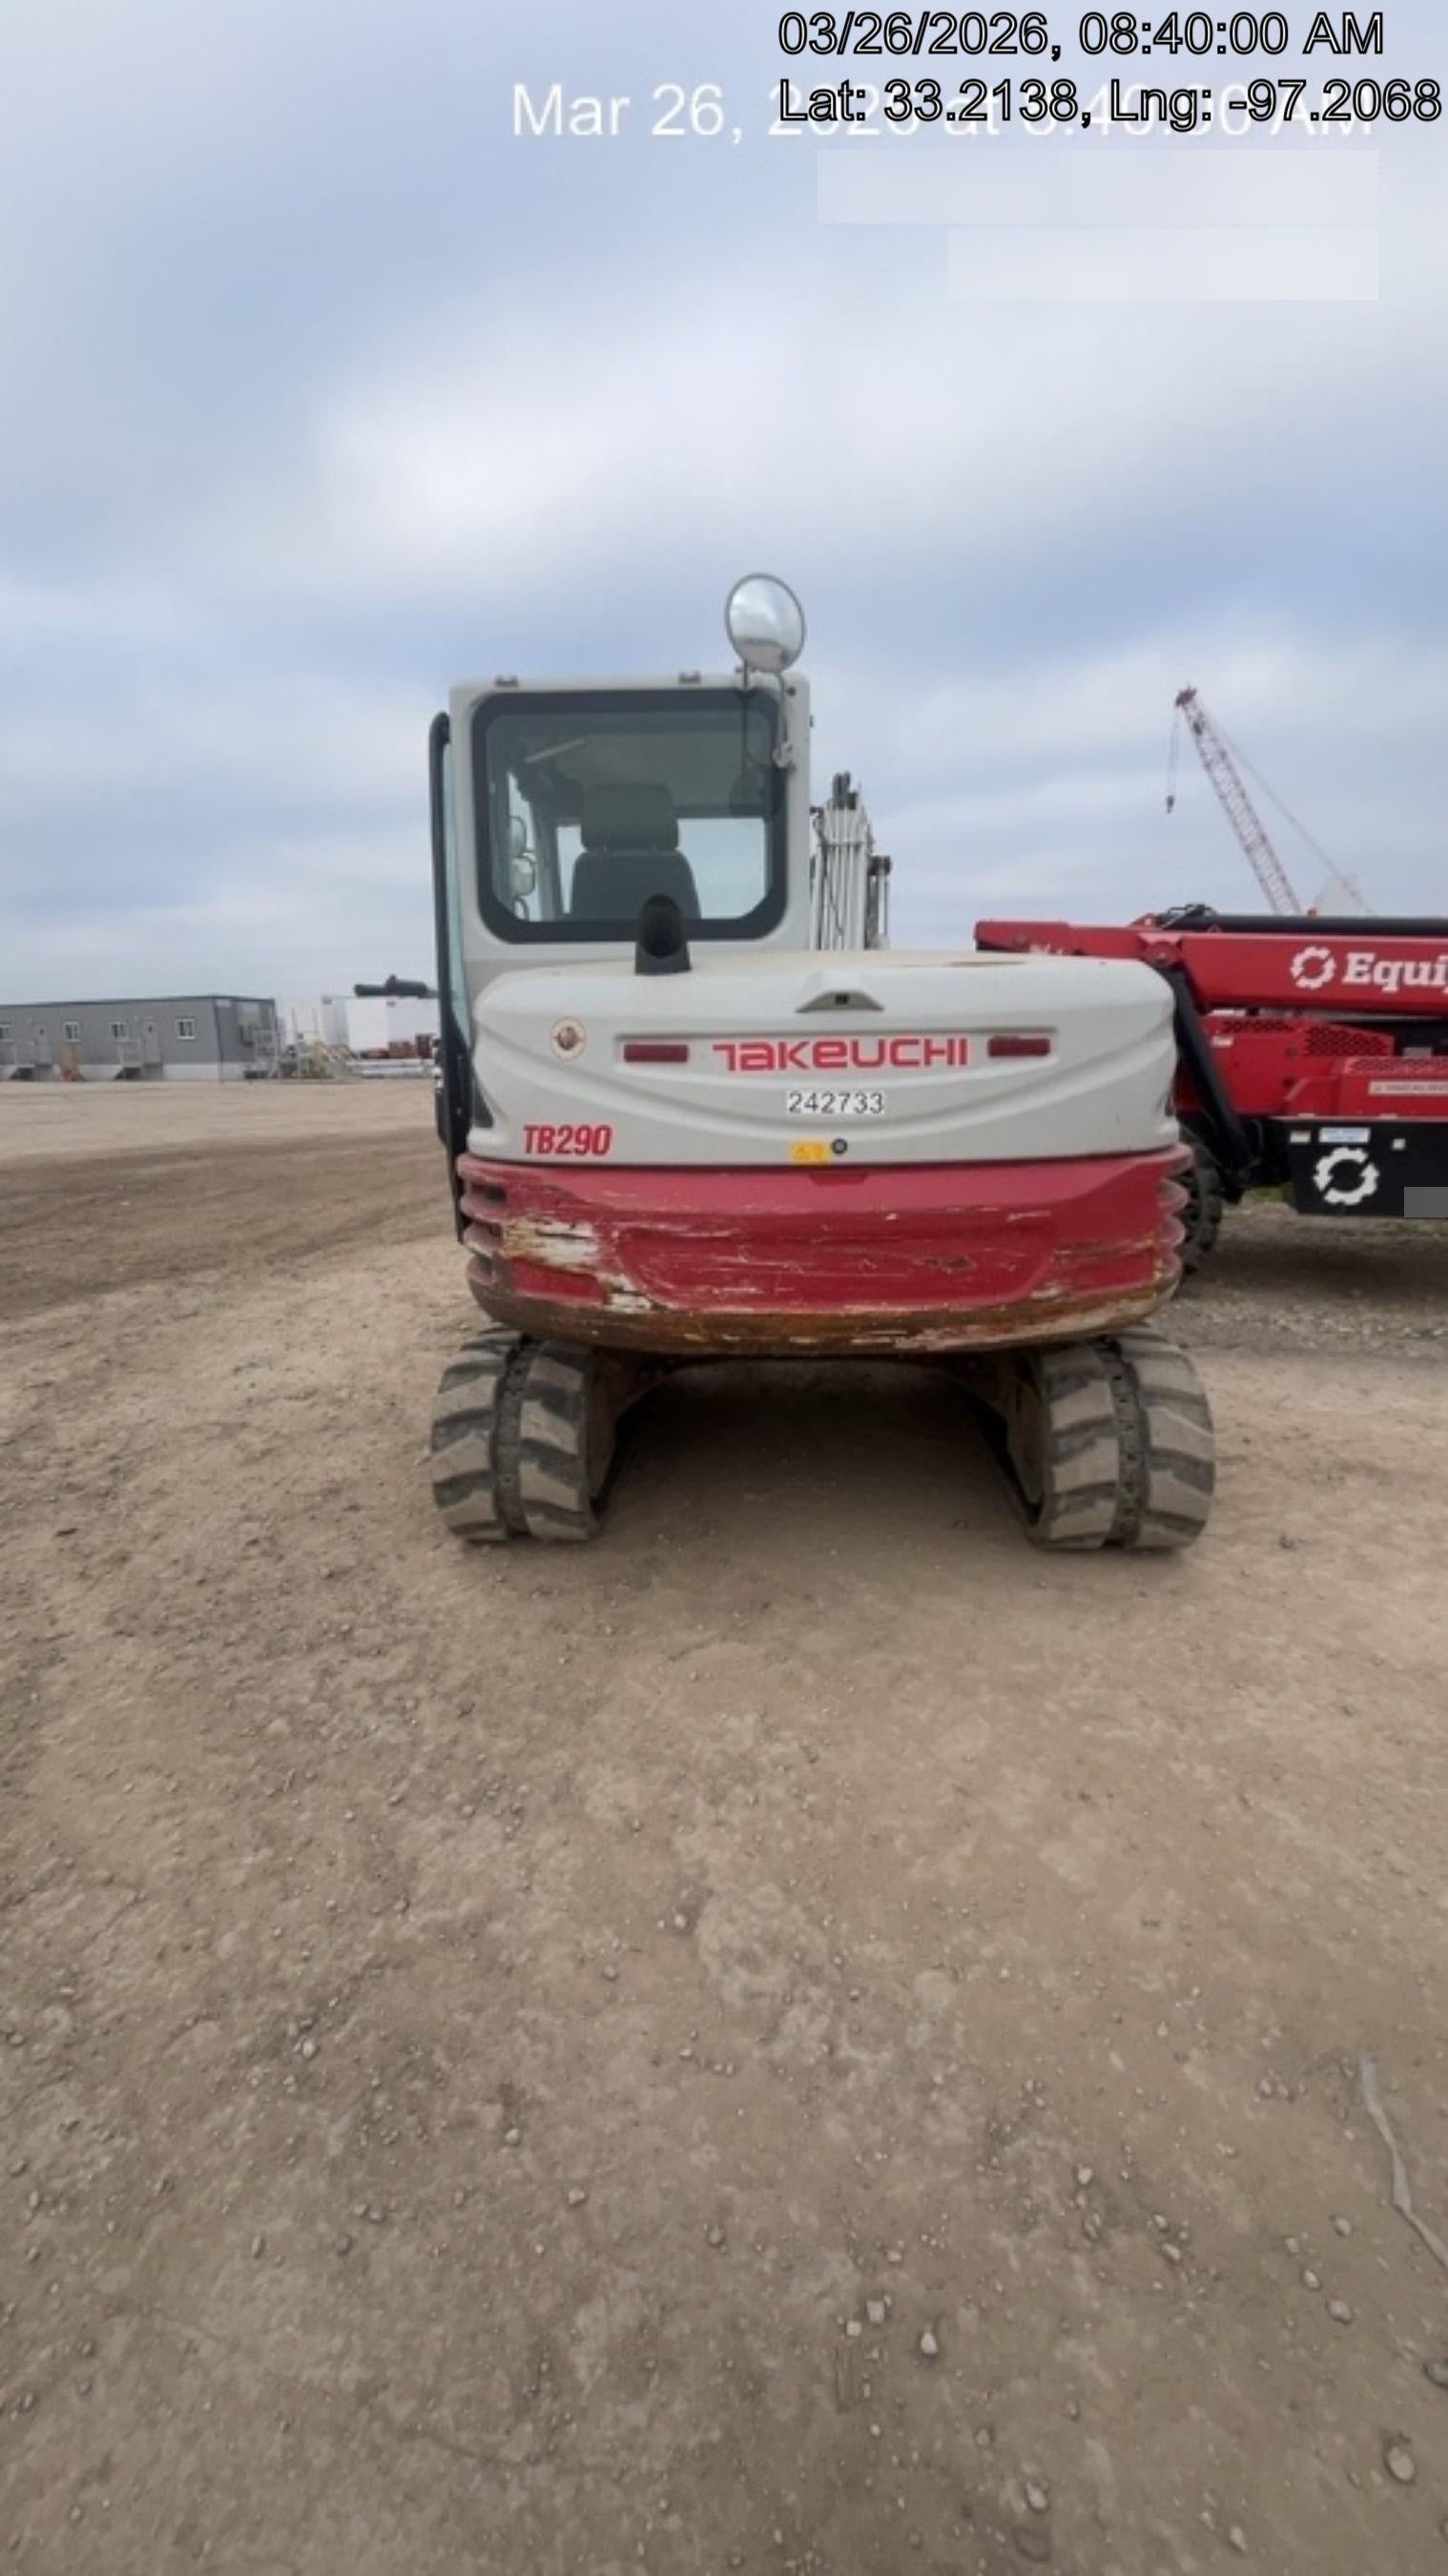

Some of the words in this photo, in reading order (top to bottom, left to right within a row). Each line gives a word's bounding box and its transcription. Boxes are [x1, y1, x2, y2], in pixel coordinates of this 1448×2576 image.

[1340, 951, 1448, 994] Equi
[787, 1090, 886, 1115] 242733
[523, 1124, 612, 1156] TB290
